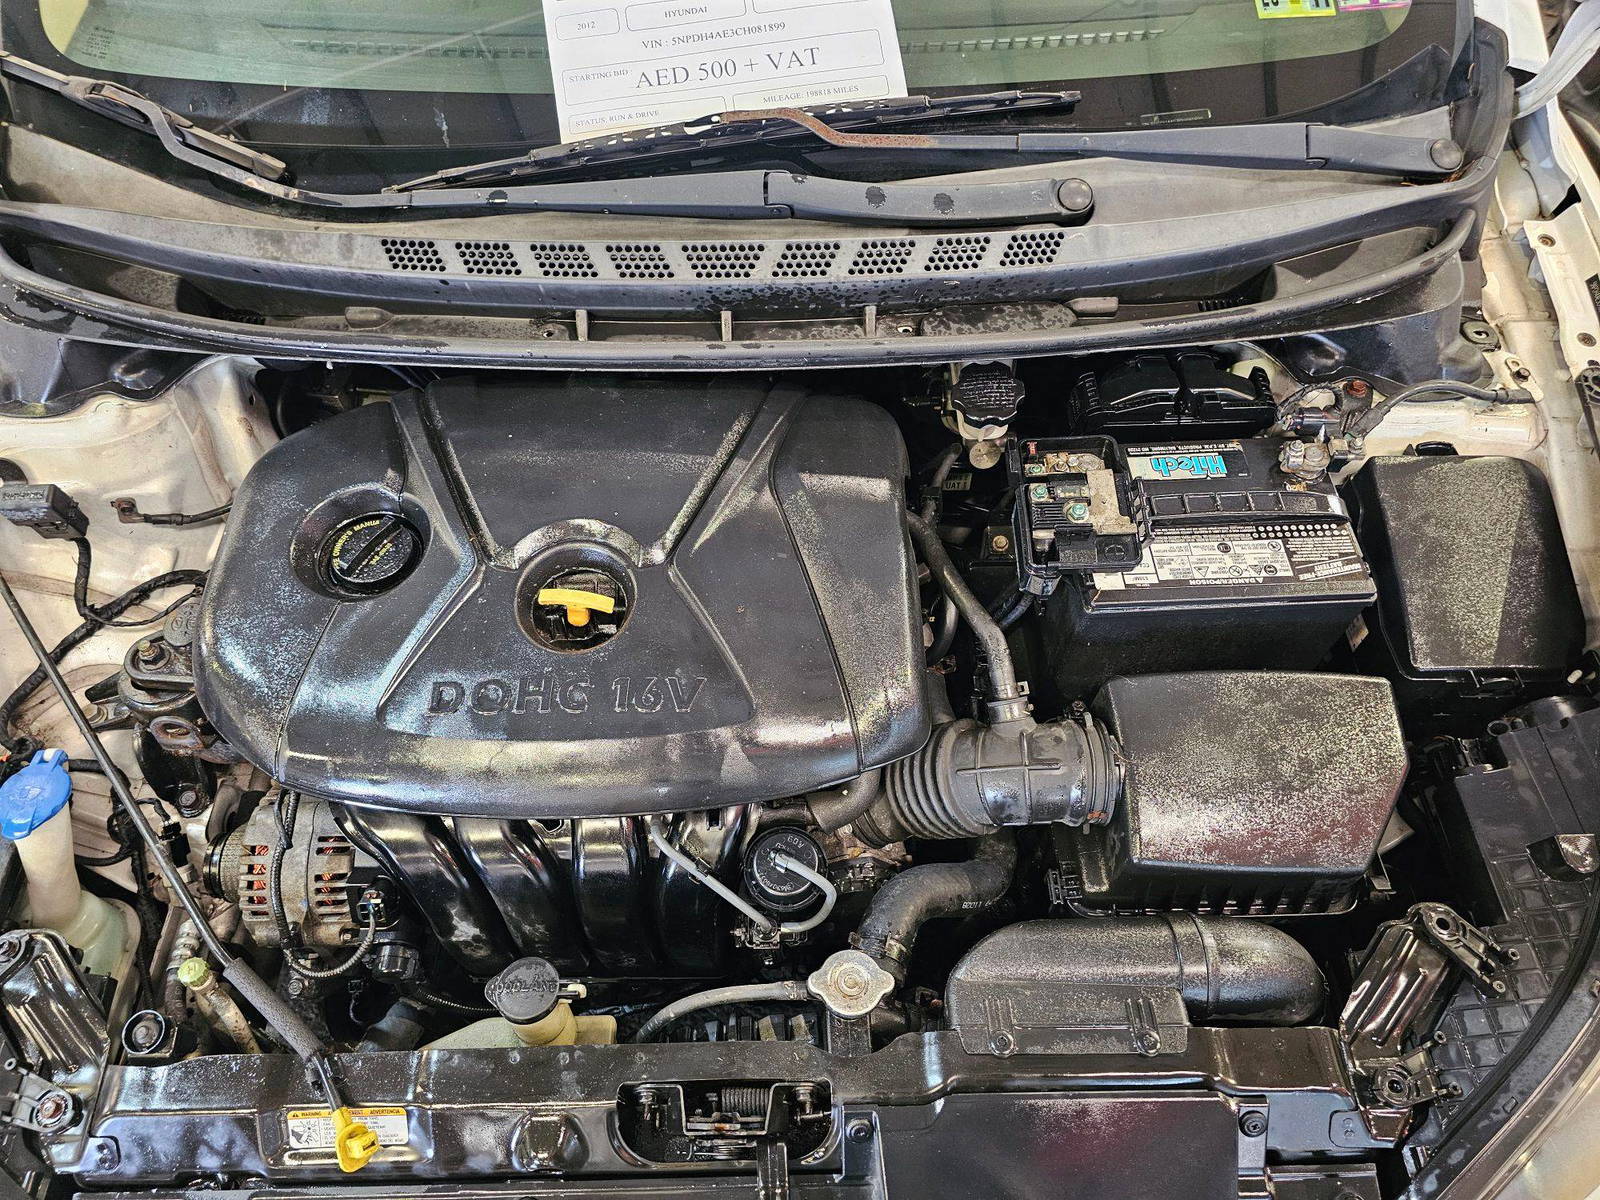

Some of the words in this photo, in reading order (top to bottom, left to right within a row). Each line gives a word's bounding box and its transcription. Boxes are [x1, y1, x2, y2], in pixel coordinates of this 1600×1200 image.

[664, 6, 708, 19] HYUNDAI
[577, 21, 596, 31] 2012
[642, 40, 662, 50] VIN
[671, 22, 786, 46] 5NPDH4AE3CH081899
[635, 66, 689, 89] AED
[698, 58, 737, 81] 500
[743, 58, 760, 73] +
[766, 47, 820, 71] VAT
[569, 71, 614, 83] STARTING
[613, 69, 629, 77] BID
[833, 85, 860, 95] MILES
[609, 114, 626, 123] RUN
[635, 110, 660, 119] DRIVE
[1150, 455, 1228, 477] HiTech
[1314, 561, 1343, 572] BATTERY
[1189, 576, 1256, 586] DANGER/POISON
[427, 676, 594, 716] DOHC
[611, 676, 707, 713] 16V
